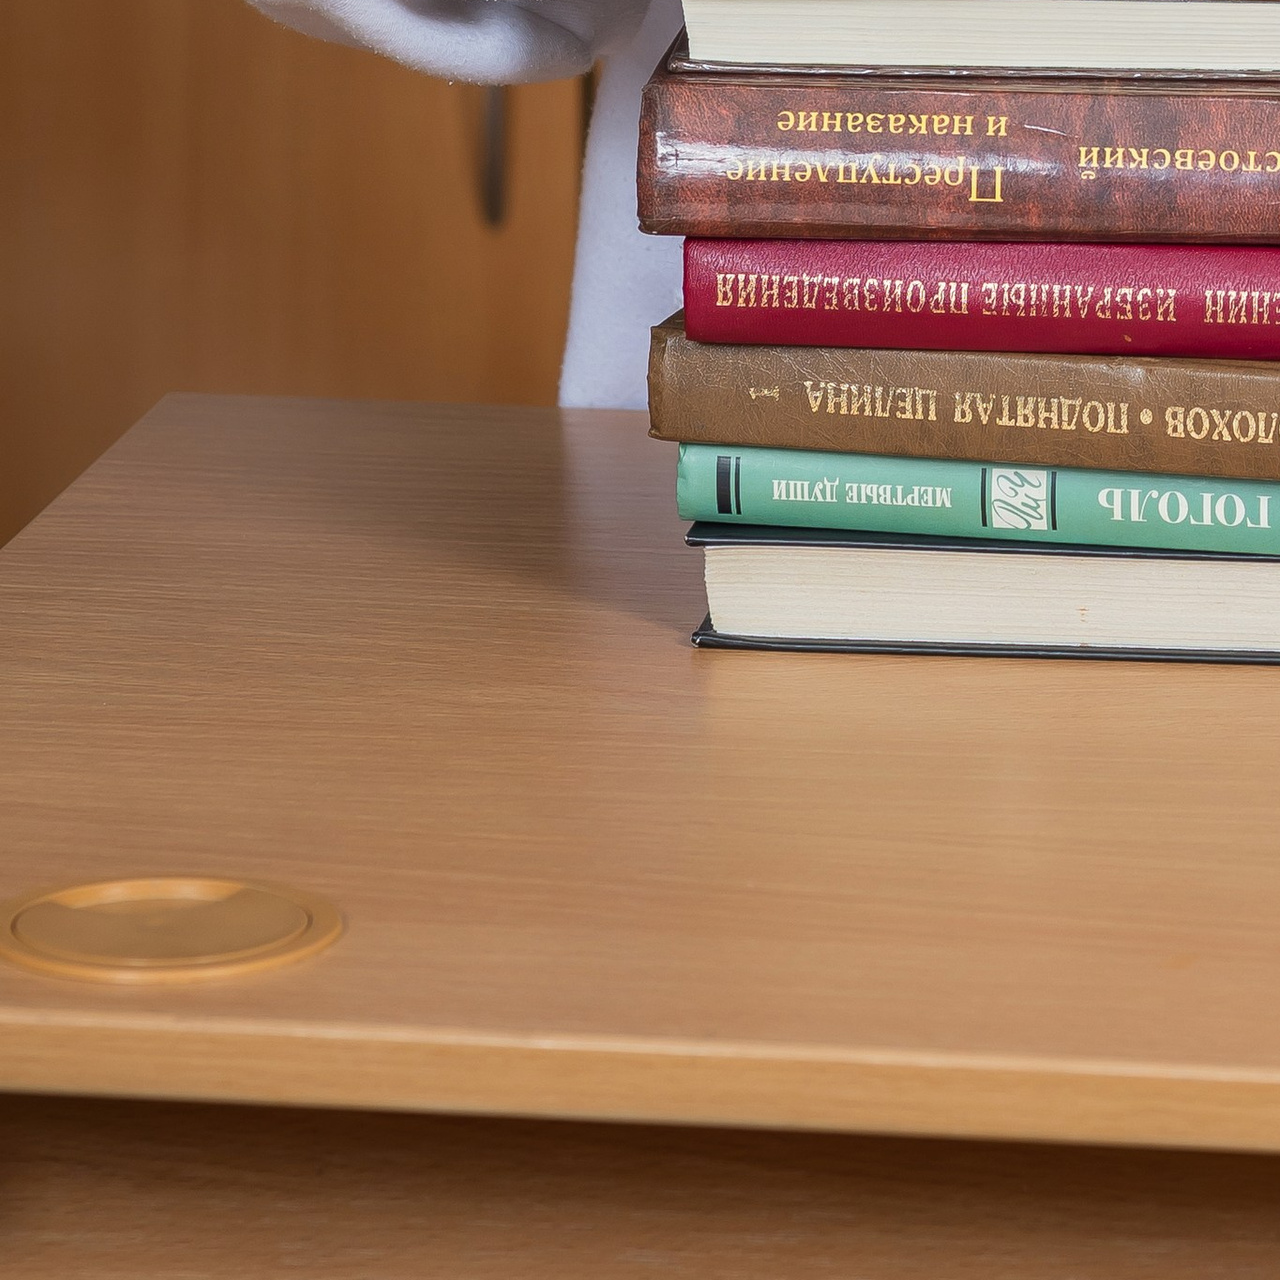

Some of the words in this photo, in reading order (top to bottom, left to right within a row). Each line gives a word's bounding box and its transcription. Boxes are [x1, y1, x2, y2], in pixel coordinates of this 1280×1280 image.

[776, 111, 974, 135] наказание
[987, 115, 1008, 133] и
[726, 154, 1004, 202] Преступление
[715, 273, 968, 315] ПРОИЗВЕДЕНИЯ
[982, 281, 1176, 322] ИЗБРАННЫЕ
[803, 381, 937, 421] ЦЕЛИНА
[954, 392, 1128, 434] ПОДНЯТАЯ
[772, 477, 840, 501] ДУШИ
[844, 481, 952, 508] МЕРТВЫЕ
[1097, 486, 1272, 529] ГОГОЛЬ
